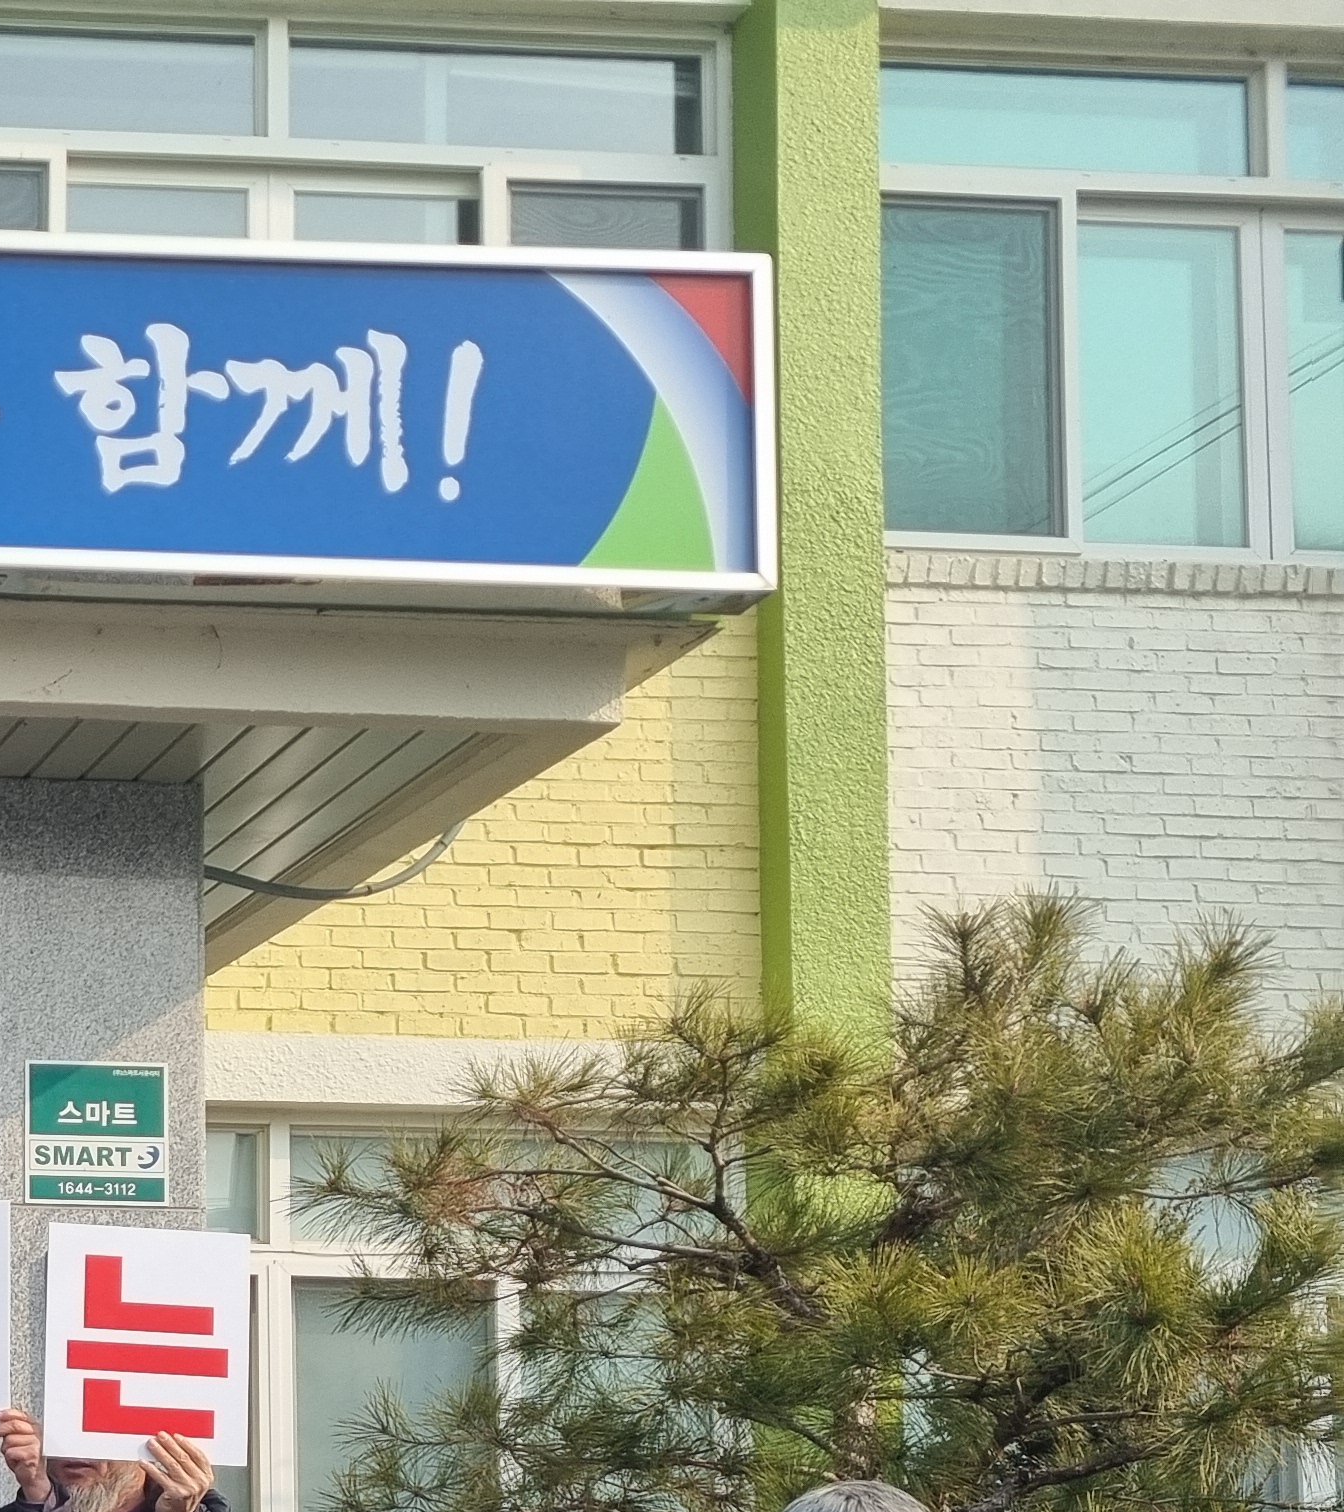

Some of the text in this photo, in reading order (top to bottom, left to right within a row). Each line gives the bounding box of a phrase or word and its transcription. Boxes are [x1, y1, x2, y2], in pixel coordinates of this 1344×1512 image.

[55, 324, 483, 501] 함께!
[58, 1101, 137, 1126] 스마트
[34, 1145, 132, 1167] SMART
[58, 1182, 136, 1196] 1644-3112
[67, 1255, 228, 1438] 는
